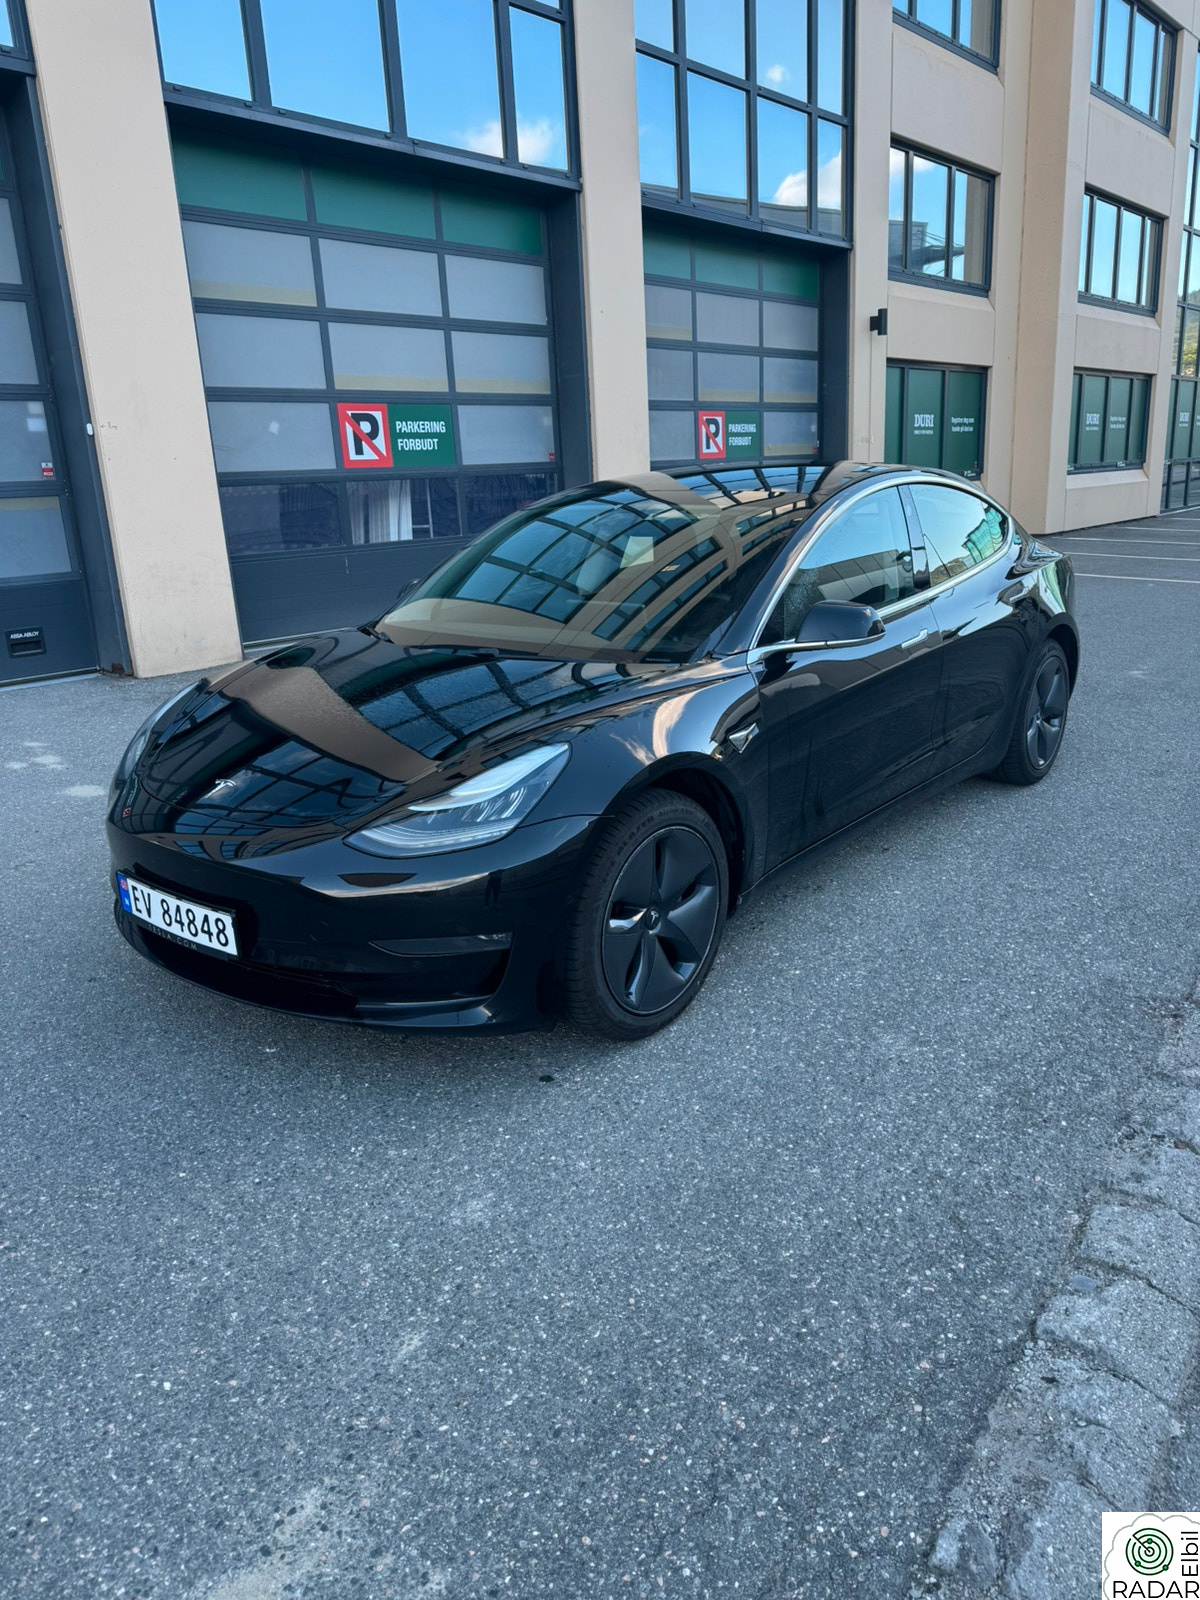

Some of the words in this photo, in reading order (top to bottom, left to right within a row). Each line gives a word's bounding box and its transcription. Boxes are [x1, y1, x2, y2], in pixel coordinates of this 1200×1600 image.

[914, 413, 935, 427] DURI
[395, 421, 446, 433] PARKERING
[728, 423, 757, 433] PARKERING
[397, 438, 439, 451] FORBUDT
[728, 436, 752, 446] FORBUDT
[131, 884, 152, 919] EV
[160, 898, 229, 948] 84848
